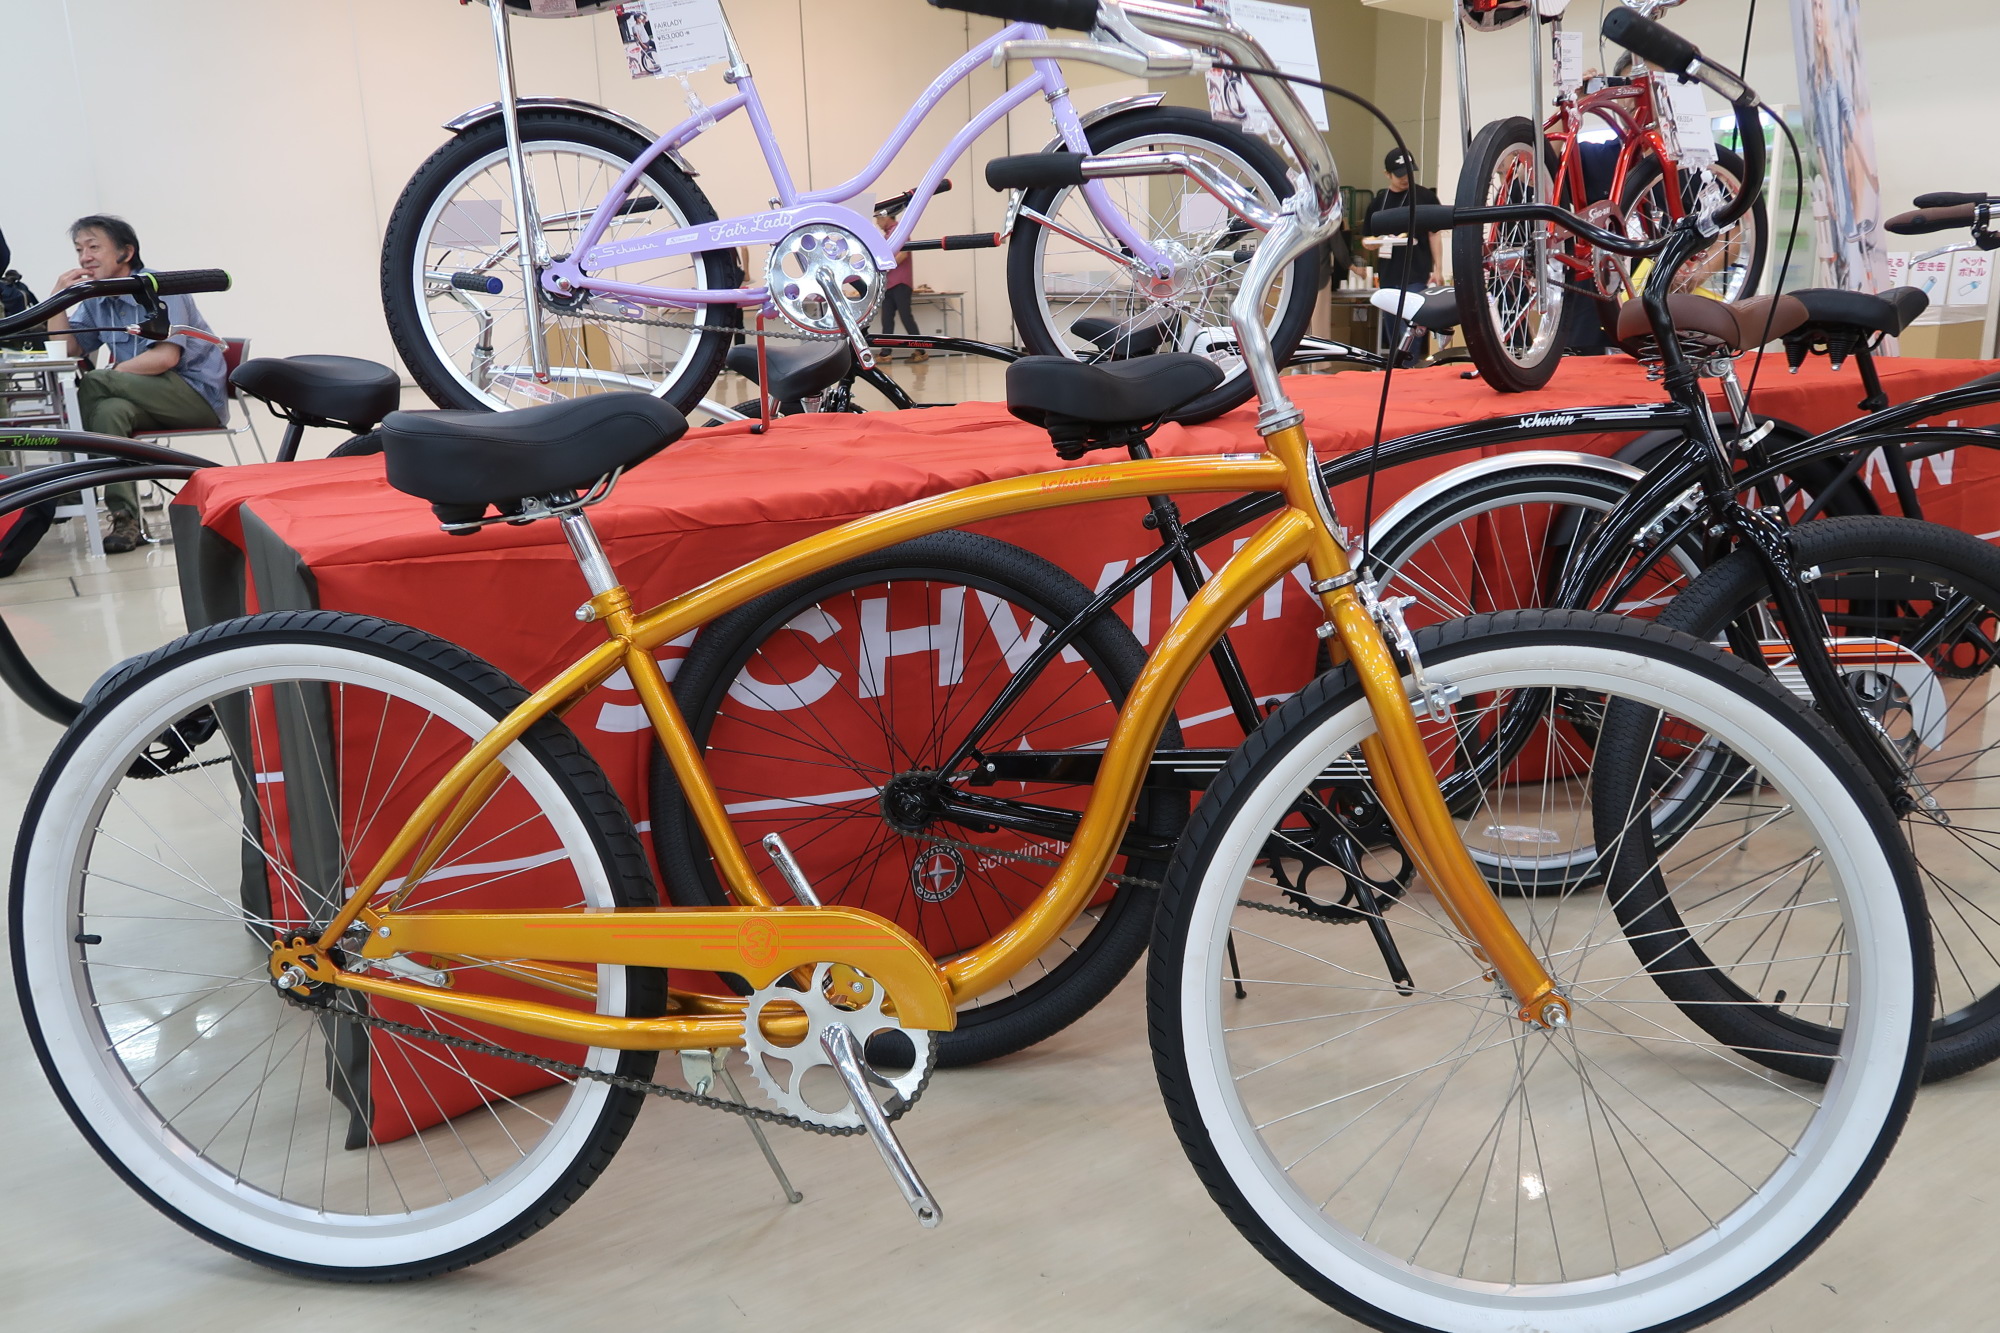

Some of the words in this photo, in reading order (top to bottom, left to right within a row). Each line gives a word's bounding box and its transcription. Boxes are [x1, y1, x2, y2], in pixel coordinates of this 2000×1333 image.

[654, 19, 683, 29] FAIRLADY
[709, 221, 750, 242] Fair
[750, 211, 794, 232] Lady
[598, 242, 659, 258] Schwinn
[1917, 262, 1946, 272] 空き缶
[1960, 257, 1987, 266] ペット
[1958, 268, 1986, 277] ボトル
[1518, 413, 1577, 429] schwinn
[1038, 472, 1113, 495] schwinn
